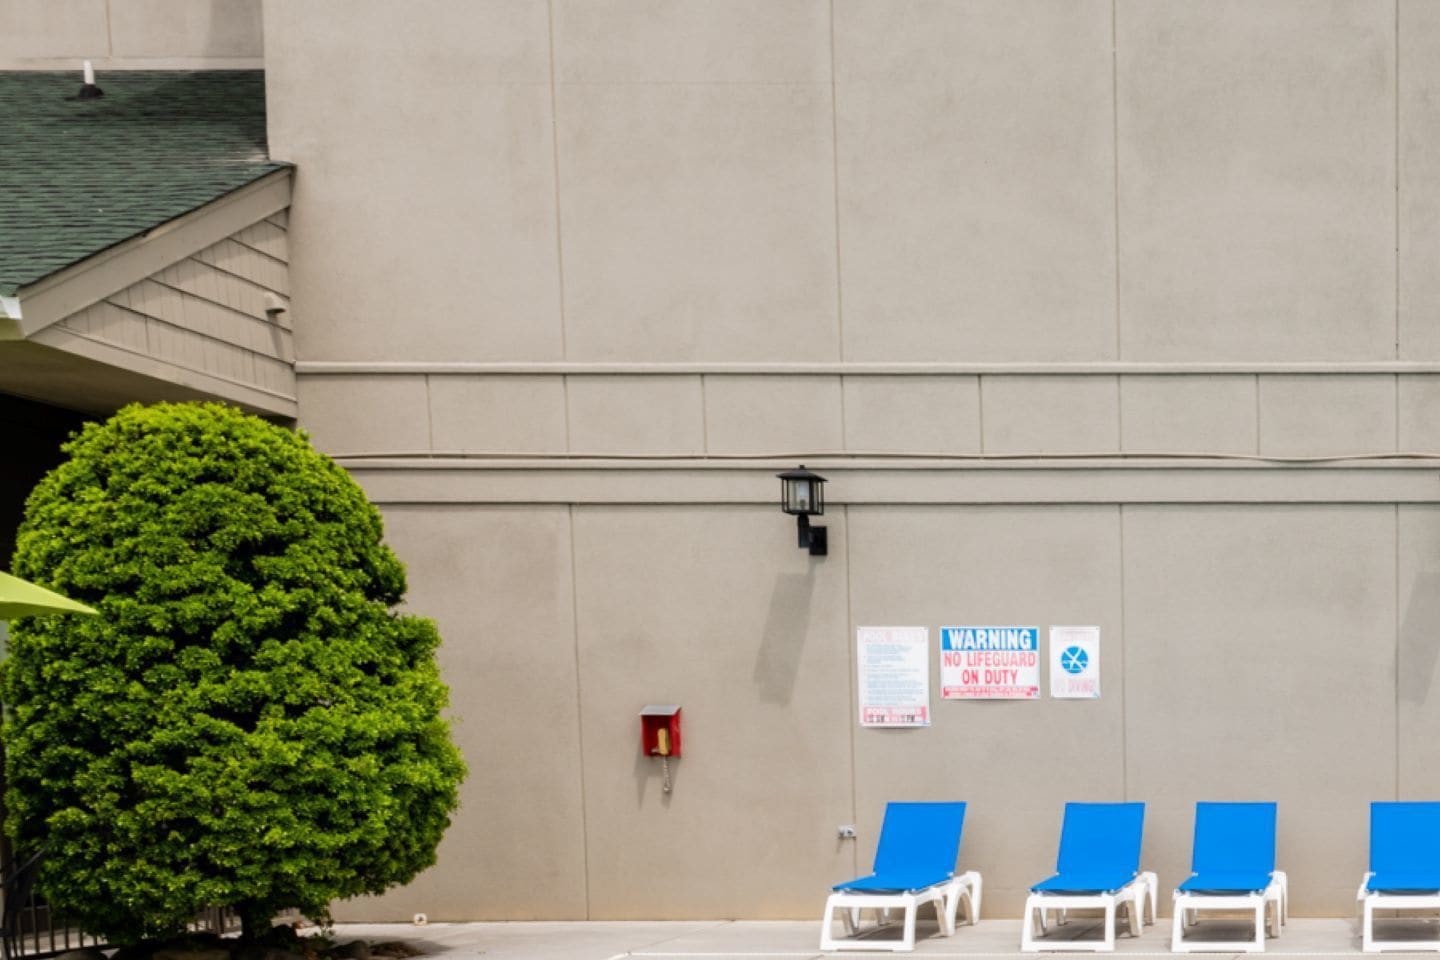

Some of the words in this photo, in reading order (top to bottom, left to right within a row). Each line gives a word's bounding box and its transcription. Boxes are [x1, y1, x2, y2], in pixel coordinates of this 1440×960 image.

[949, 629, 1032, 650] WARNING
[943, 652, 961, 667] NO
[966, 652, 1036, 667] LIFEGUARD
[962, 669, 979, 685] ON
[985, 669, 1018, 685] DUTY
